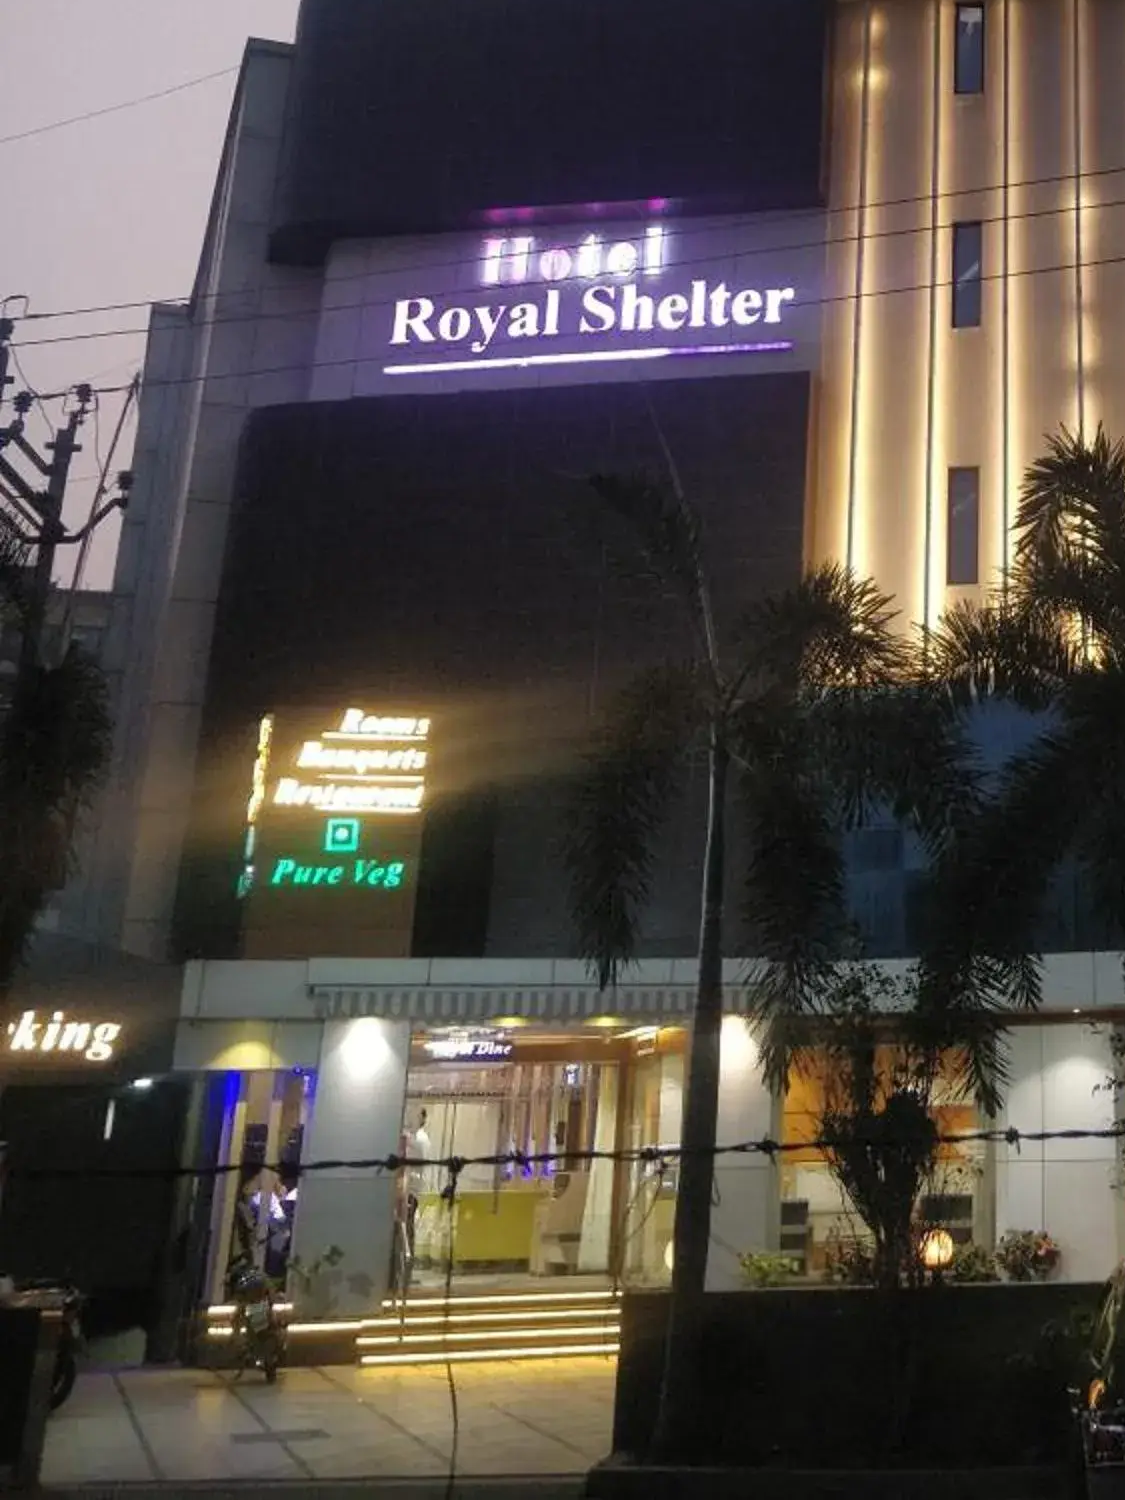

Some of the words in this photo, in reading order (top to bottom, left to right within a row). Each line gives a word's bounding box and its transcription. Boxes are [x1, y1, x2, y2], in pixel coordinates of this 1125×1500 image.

[479, 227, 664, 287] Hotel
[389, 290, 560, 352] Royal
[579, 279, 795, 334] Shelter
[271, 859, 345, 885] Pure
[354, 859, 405, 888] Veg
[7, 1010, 122, 1061] king
